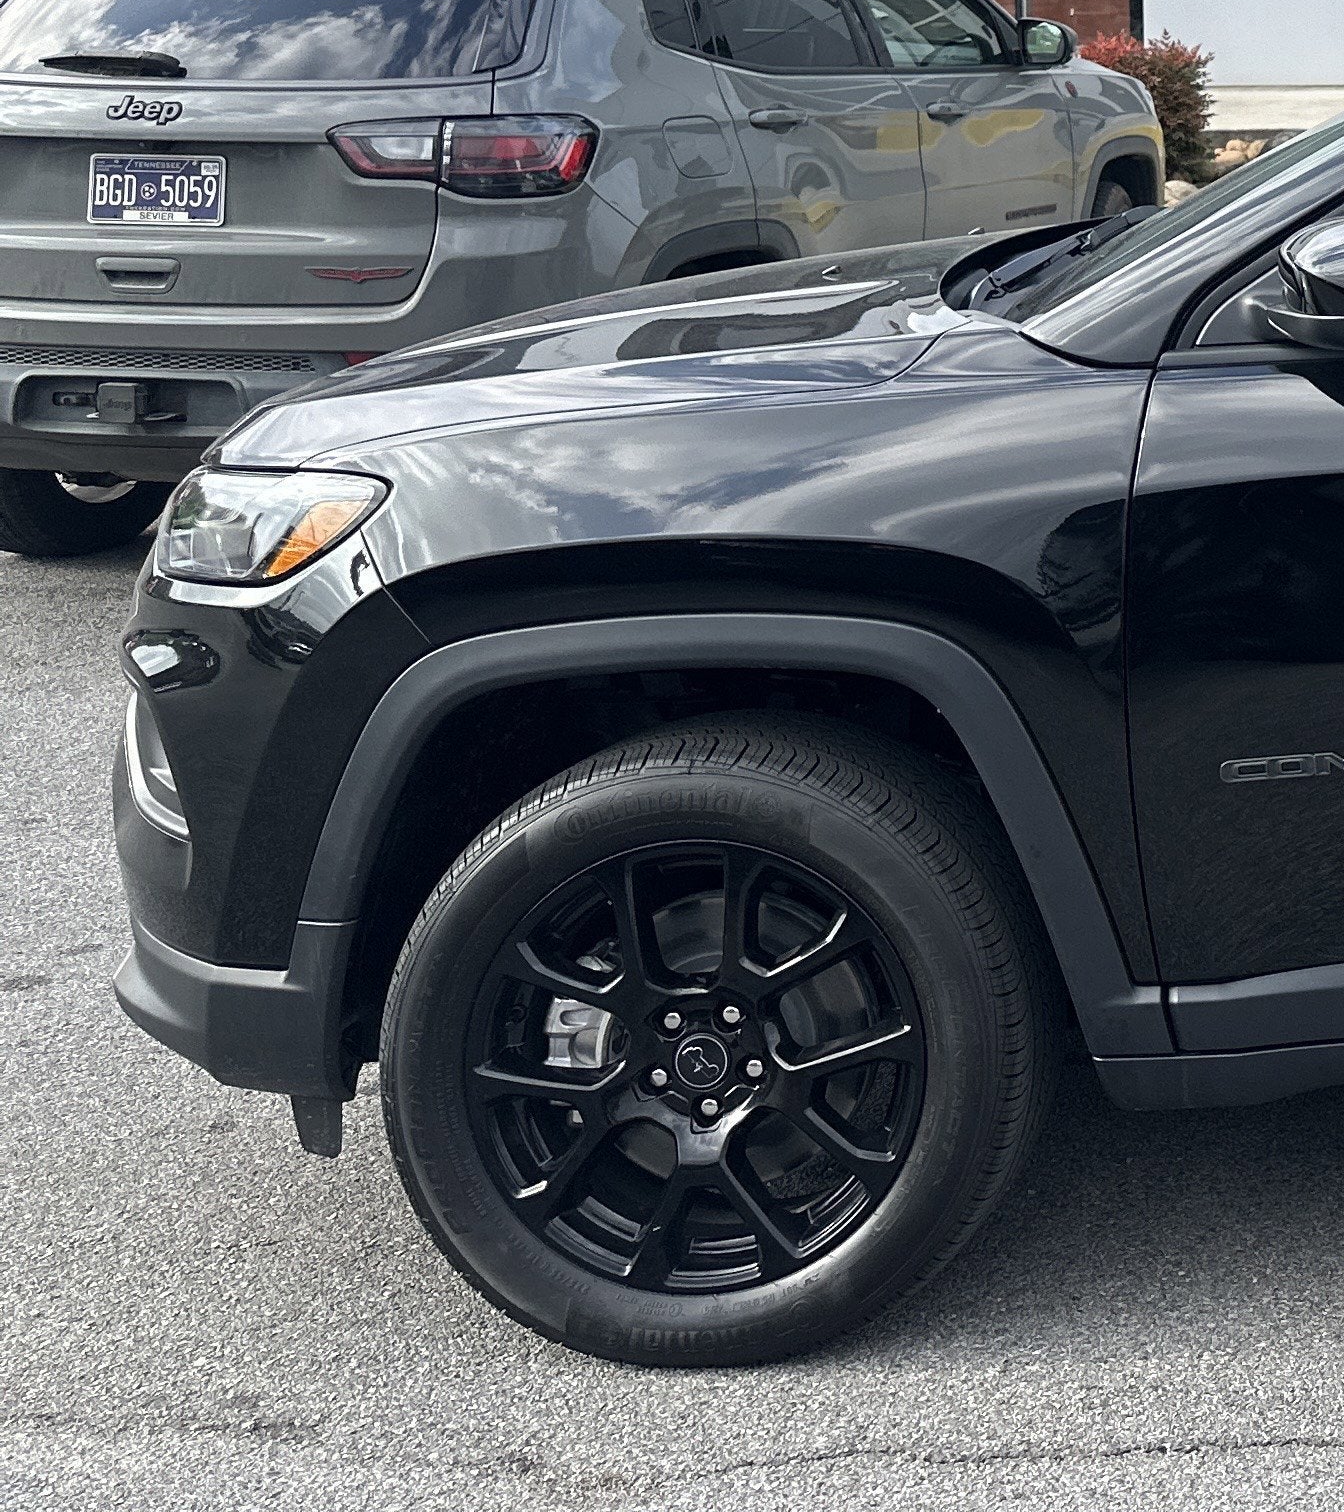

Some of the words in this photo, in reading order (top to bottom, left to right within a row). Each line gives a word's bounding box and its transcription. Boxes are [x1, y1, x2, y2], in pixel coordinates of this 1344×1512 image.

[106, 95, 183, 125] Jeep
[94, 174, 137, 206] BGD
[160, 175, 217, 208] 5059
[139, 212, 174, 221] SEVIER
